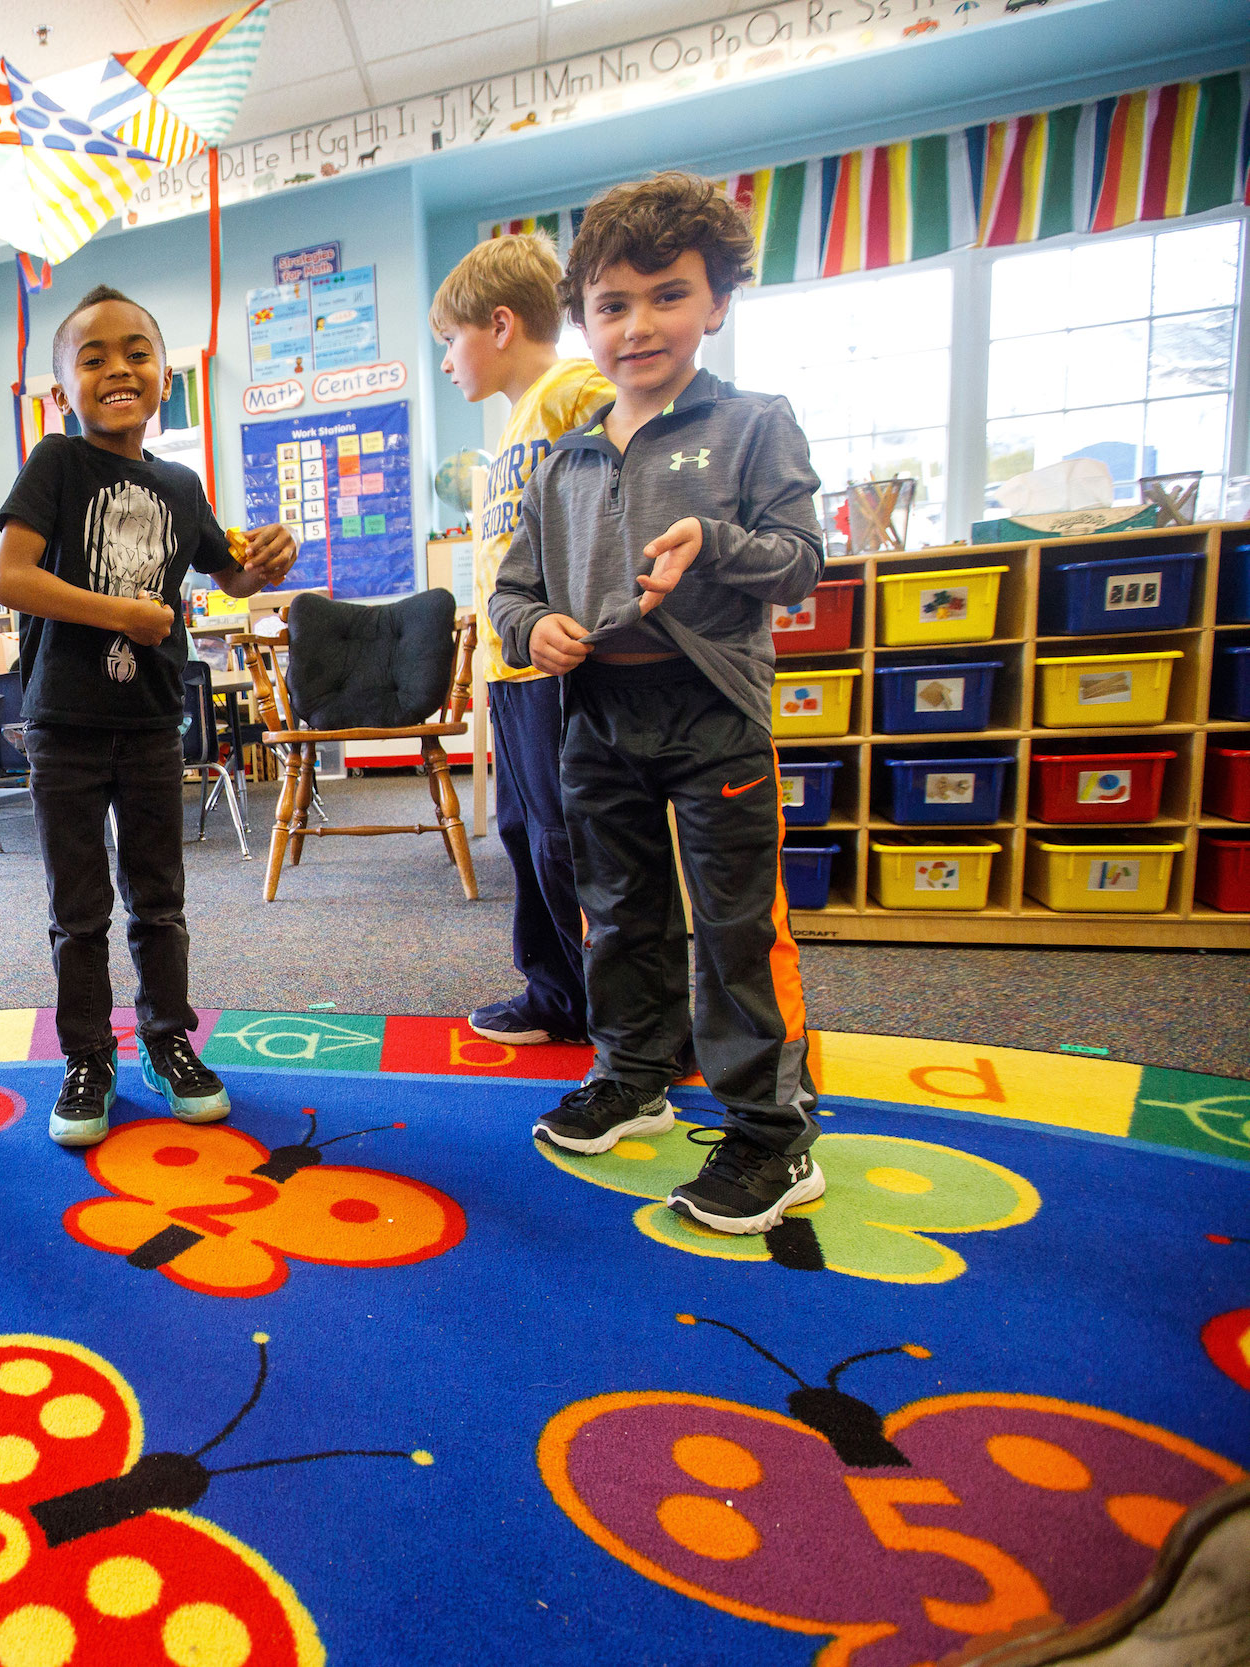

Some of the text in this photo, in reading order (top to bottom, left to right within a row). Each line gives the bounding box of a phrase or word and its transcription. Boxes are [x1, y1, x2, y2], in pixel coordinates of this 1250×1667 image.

[278, 248, 336, 269] Strategies
[282, 260, 334, 282] for Math
[249, 366, 401, 409] Math Centers
[292, 423, 357, 439] Work Stations
[310, 464, 317, 476] 2
[310, 484, 318, 496] 3
[311, 503, 318, 515] 4
[312, 525, 320, 536] 5
[255, 1031, 320, 1060] a
[449, 1028, 517, 1067] b
[908, 1058, 1007, 1103] d
[165, 1175, 280, 1238] 2
[841, 1475, 1060, 1635] 5
